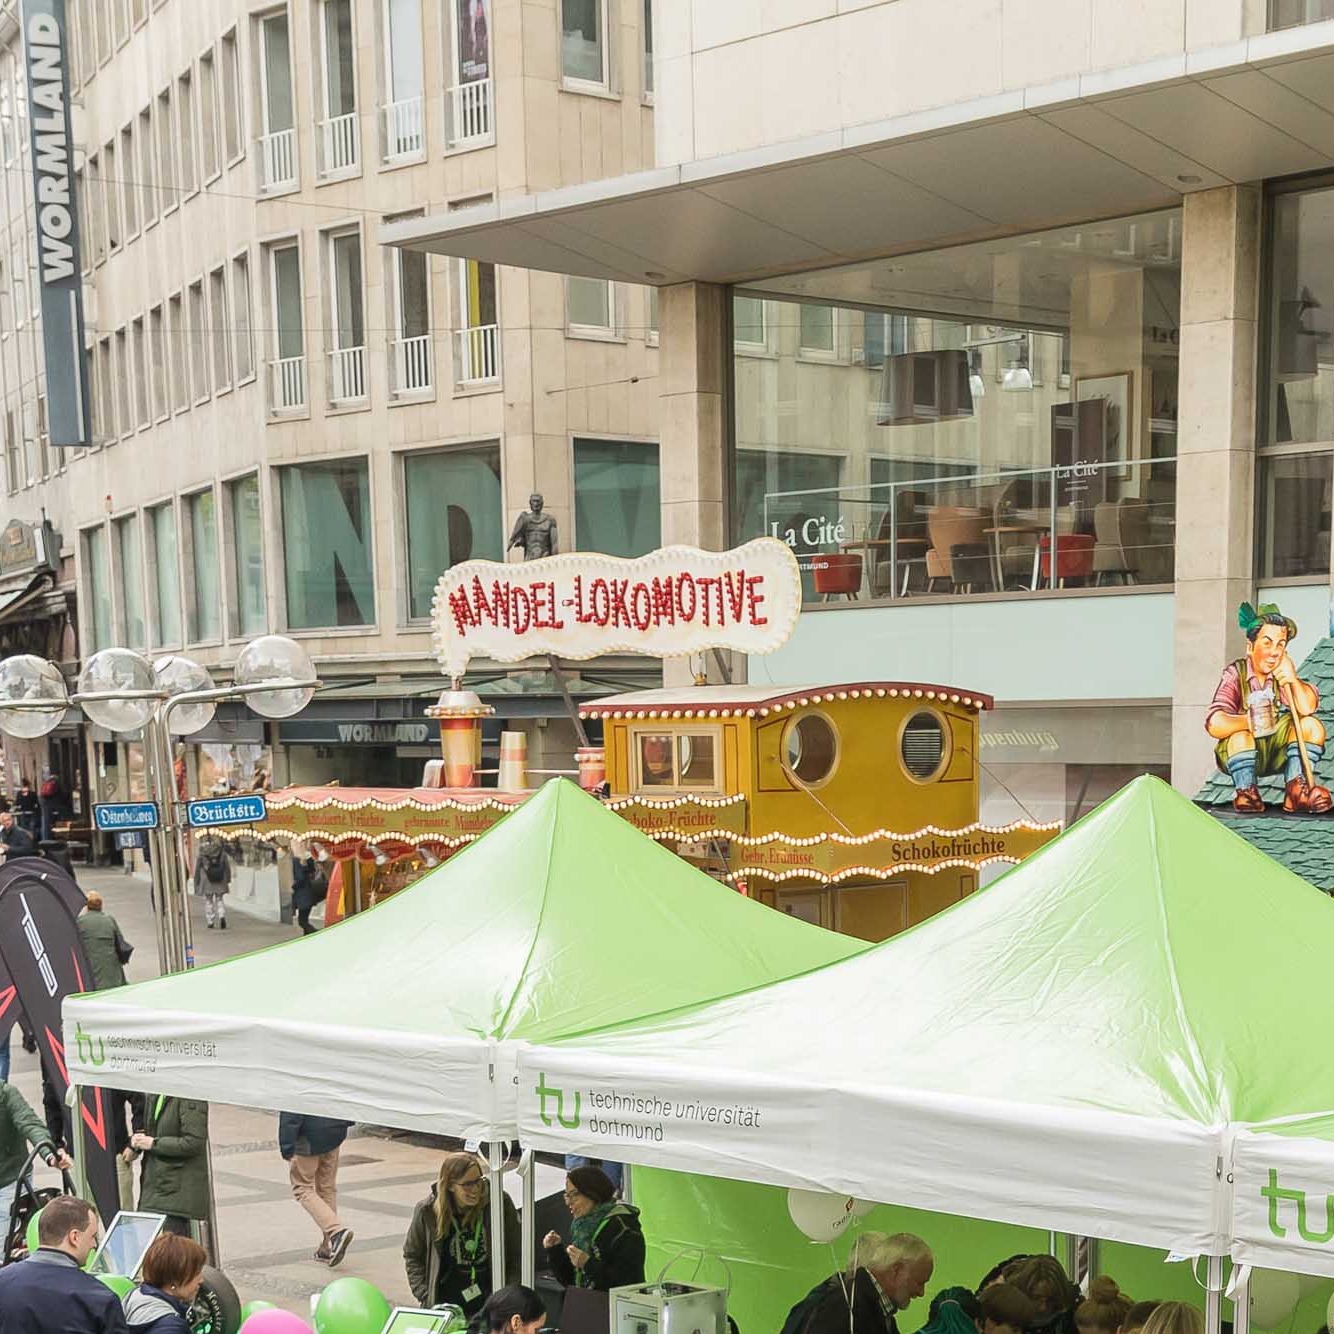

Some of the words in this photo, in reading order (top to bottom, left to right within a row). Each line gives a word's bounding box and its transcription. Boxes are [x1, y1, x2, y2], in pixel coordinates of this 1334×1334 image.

[28, 12, 75, 284] WORMLAND
[771, 521, 796, 548] La
[802, 515, 845, 547] Cité
[448, 568, 768, 637] MANDEL-LOKOMOTIVE
[338, 723, 430, 743] WORMLAND
[194, 798, 260, 822] Brückstr.
[891, 838, 1006, 862] Schokofrüchte
[107, 1034, 161, 1051] technische
[162, 1038, 218, 1058] universität
[110, 1055, 157, 1073] dortmund
[535, 1072, 581, 1129] tu
[589, 1088, 672, 1117] technische
[675, 1100, 762, 1128] universität
[589, 1115, 664, 1142] dortmund
